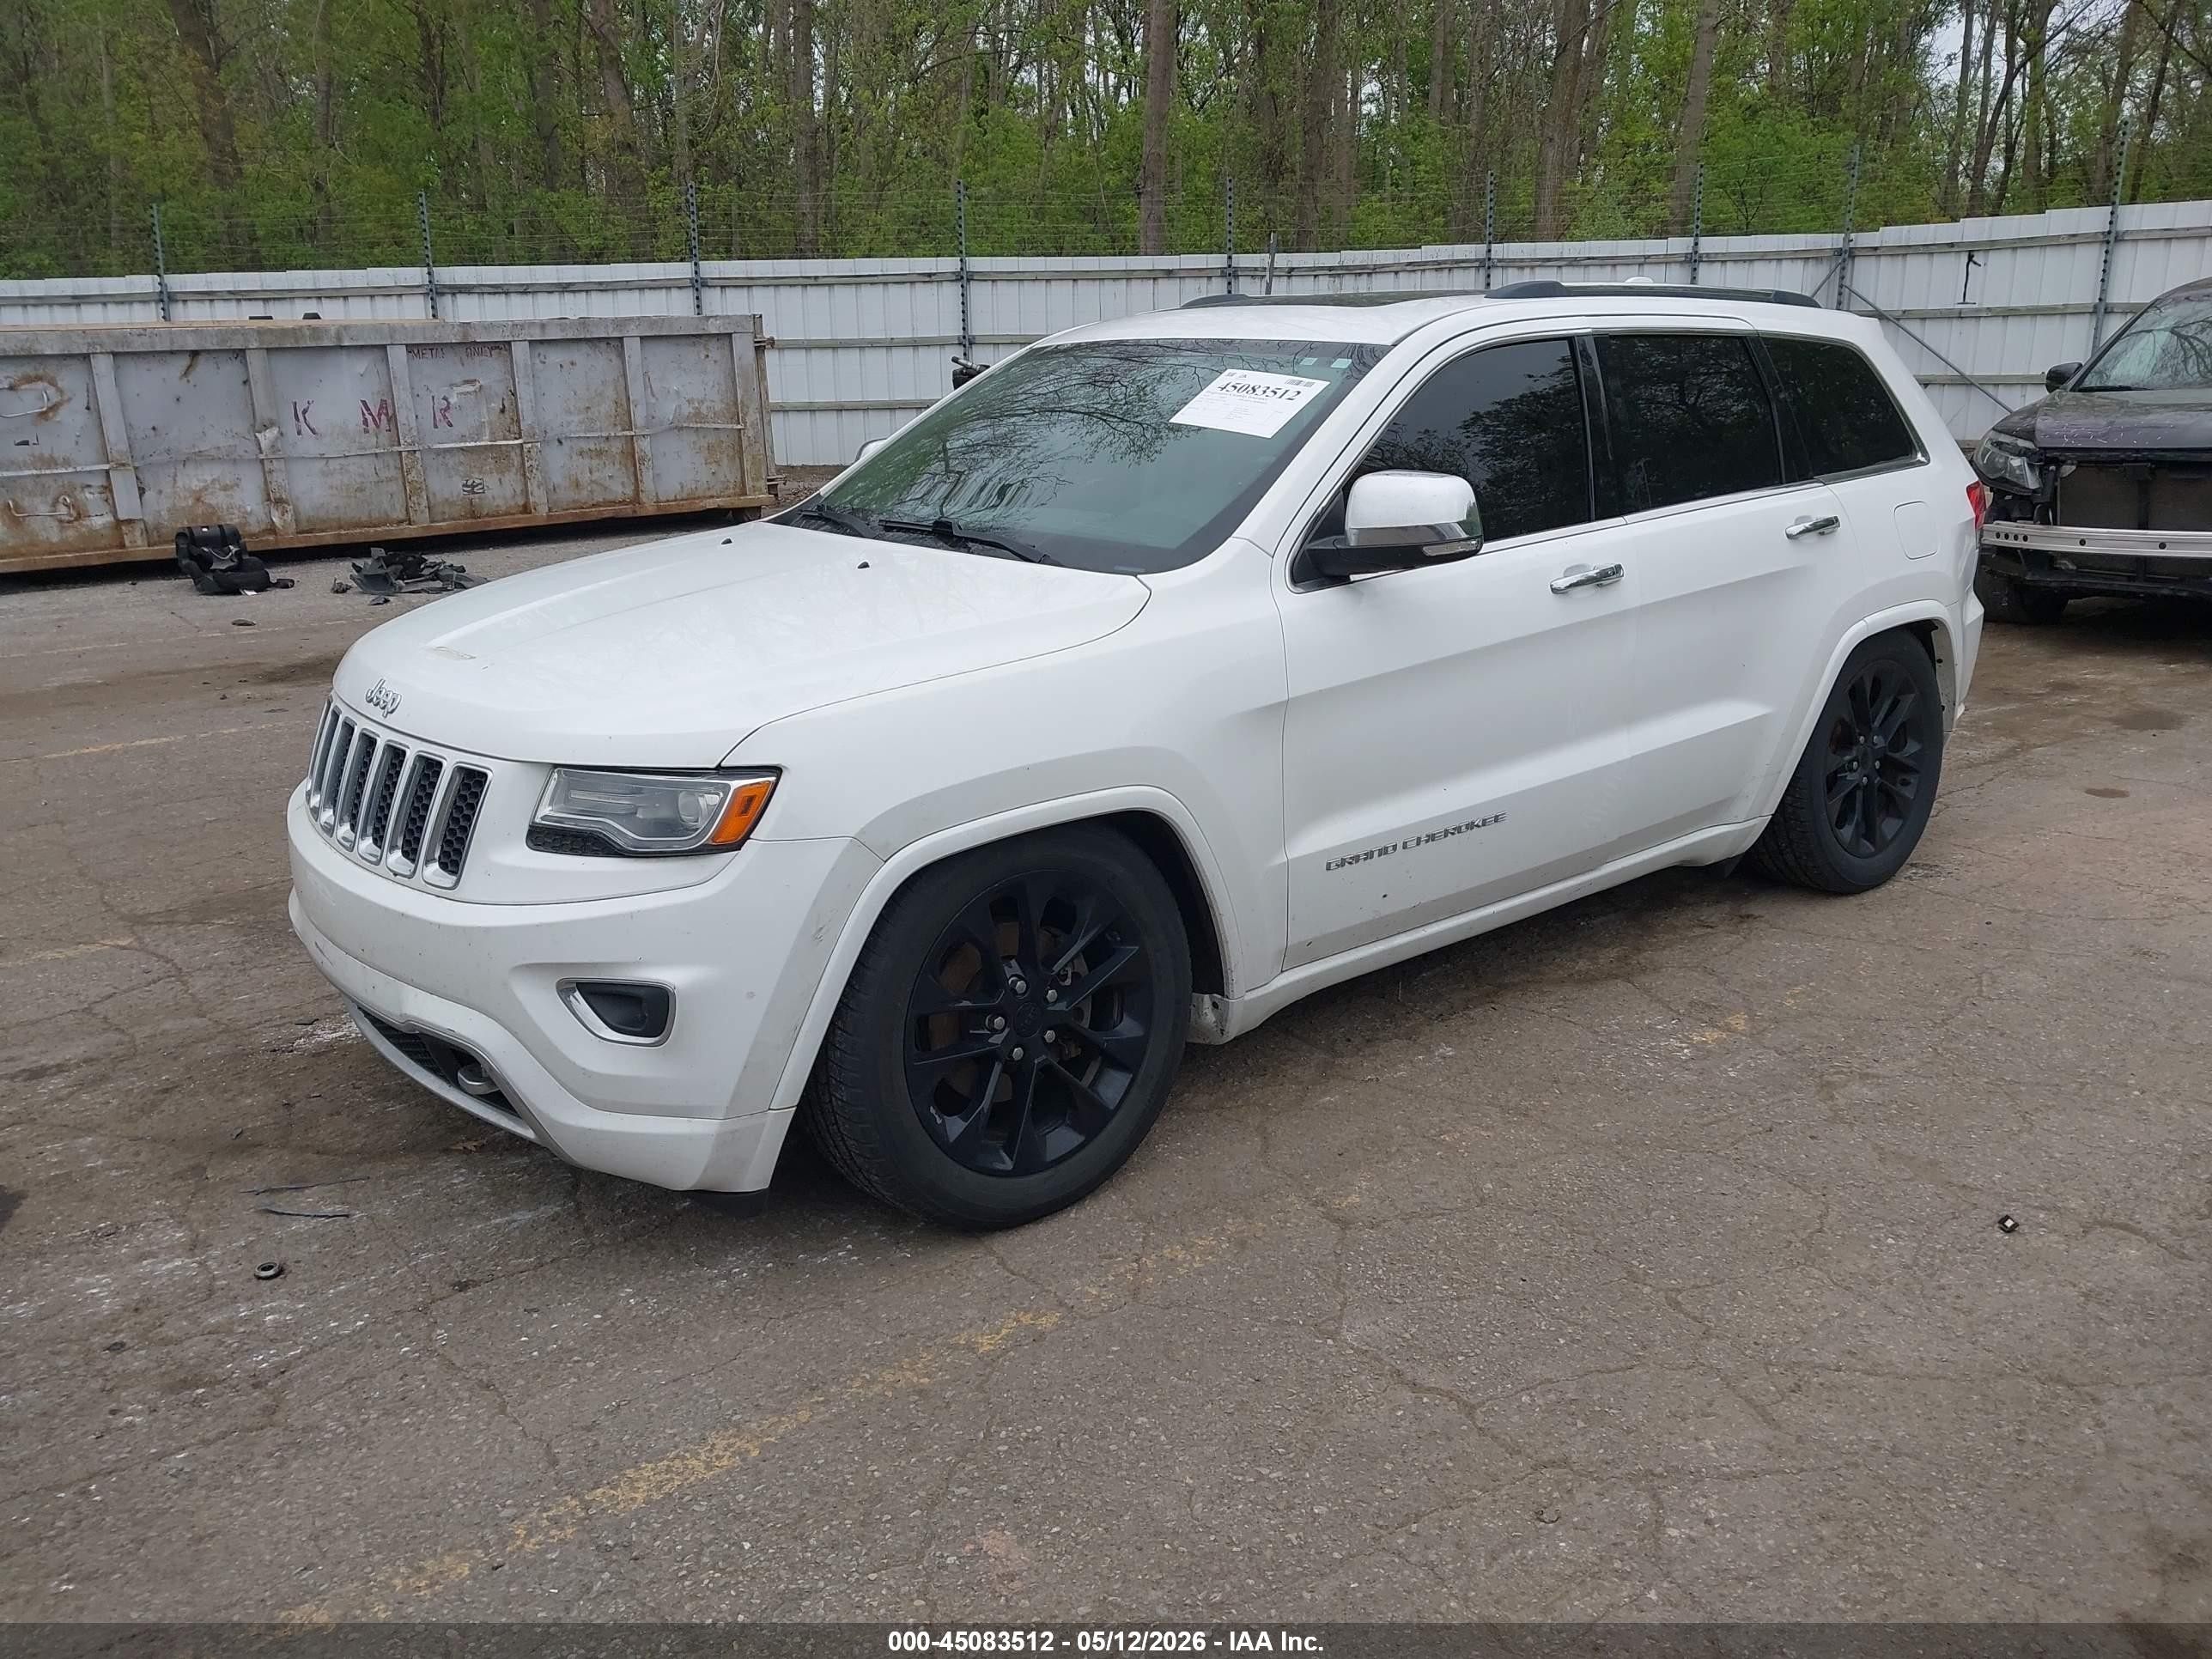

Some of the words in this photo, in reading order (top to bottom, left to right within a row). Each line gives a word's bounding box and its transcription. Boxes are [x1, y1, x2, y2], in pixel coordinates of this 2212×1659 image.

[1218, 381, 1302, 401] 45083512
[293, 399, 319, 437] K
[360, 398, 392, 434] M
[431, 395, 453, 429] R
[365, 678, 403, 719] Jeep
[1325, 841, 1399, 872] GRAND
[1401, 810, 1509, 850] CHEROKEE
